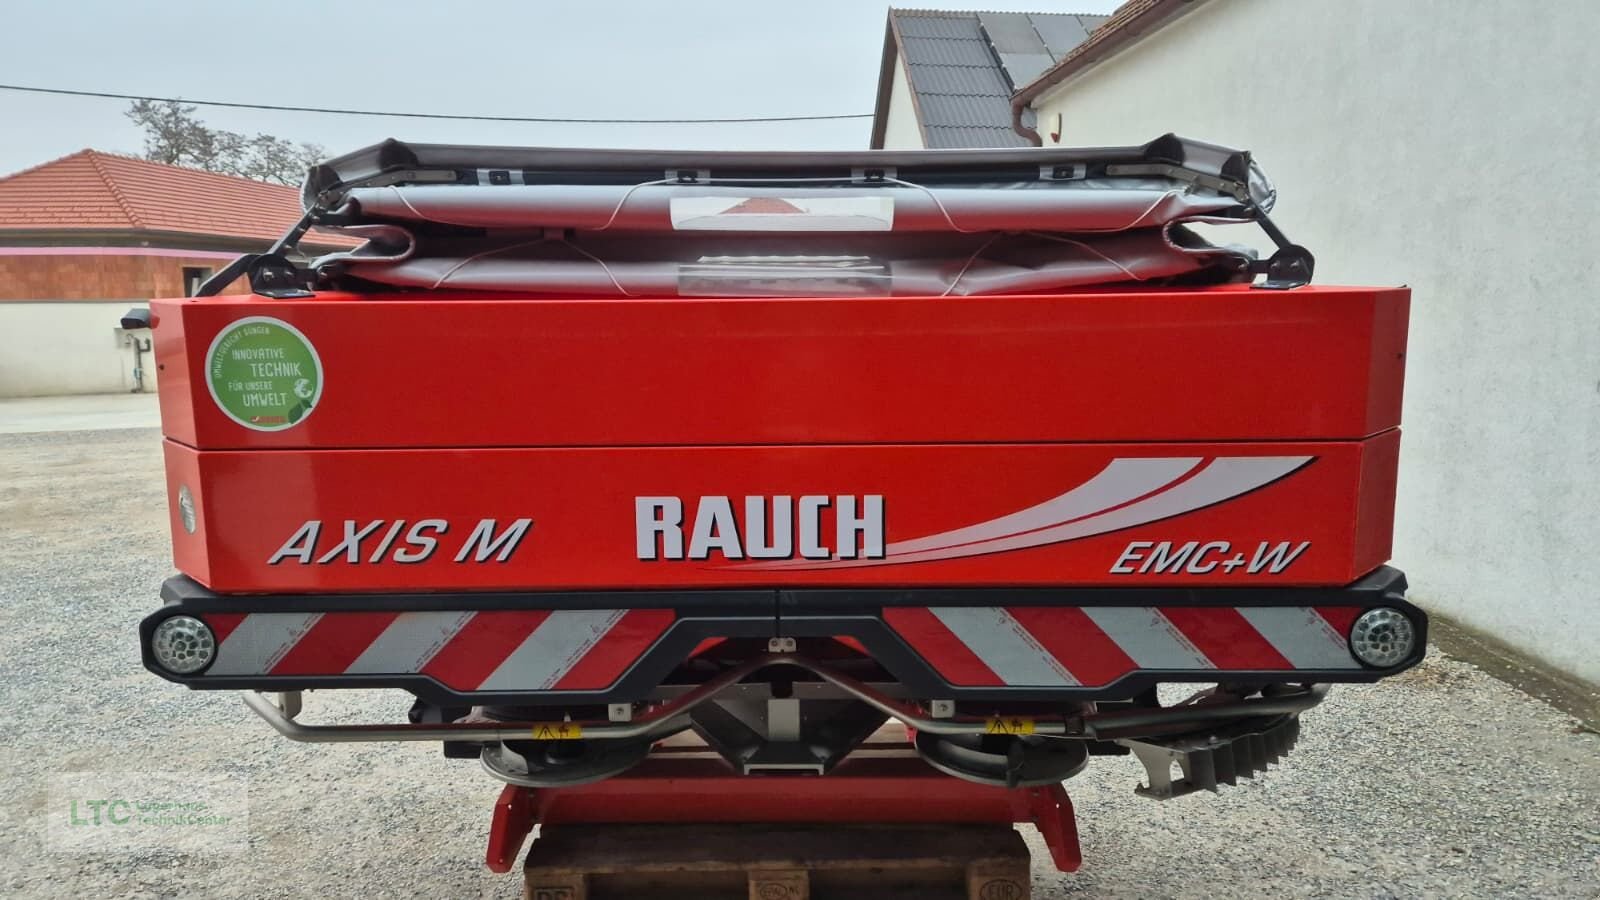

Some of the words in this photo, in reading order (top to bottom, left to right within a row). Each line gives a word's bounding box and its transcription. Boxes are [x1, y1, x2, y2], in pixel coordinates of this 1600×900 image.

[231, 348, 285, 360] INNOVATIVE
[250, 362, 302, 377] TECHNIK
[228, 380, 243, 391] FÜR
[245, 381, 273, 391] UNSERE
[242, 392, 287, 407] UMWELT
[634, 494, 887, 562] RAUCH
[266, 518, 449, 566] AXIS
[453, 517, 534, 564] M
[1108, 540, 1313, 575] EMC+W
